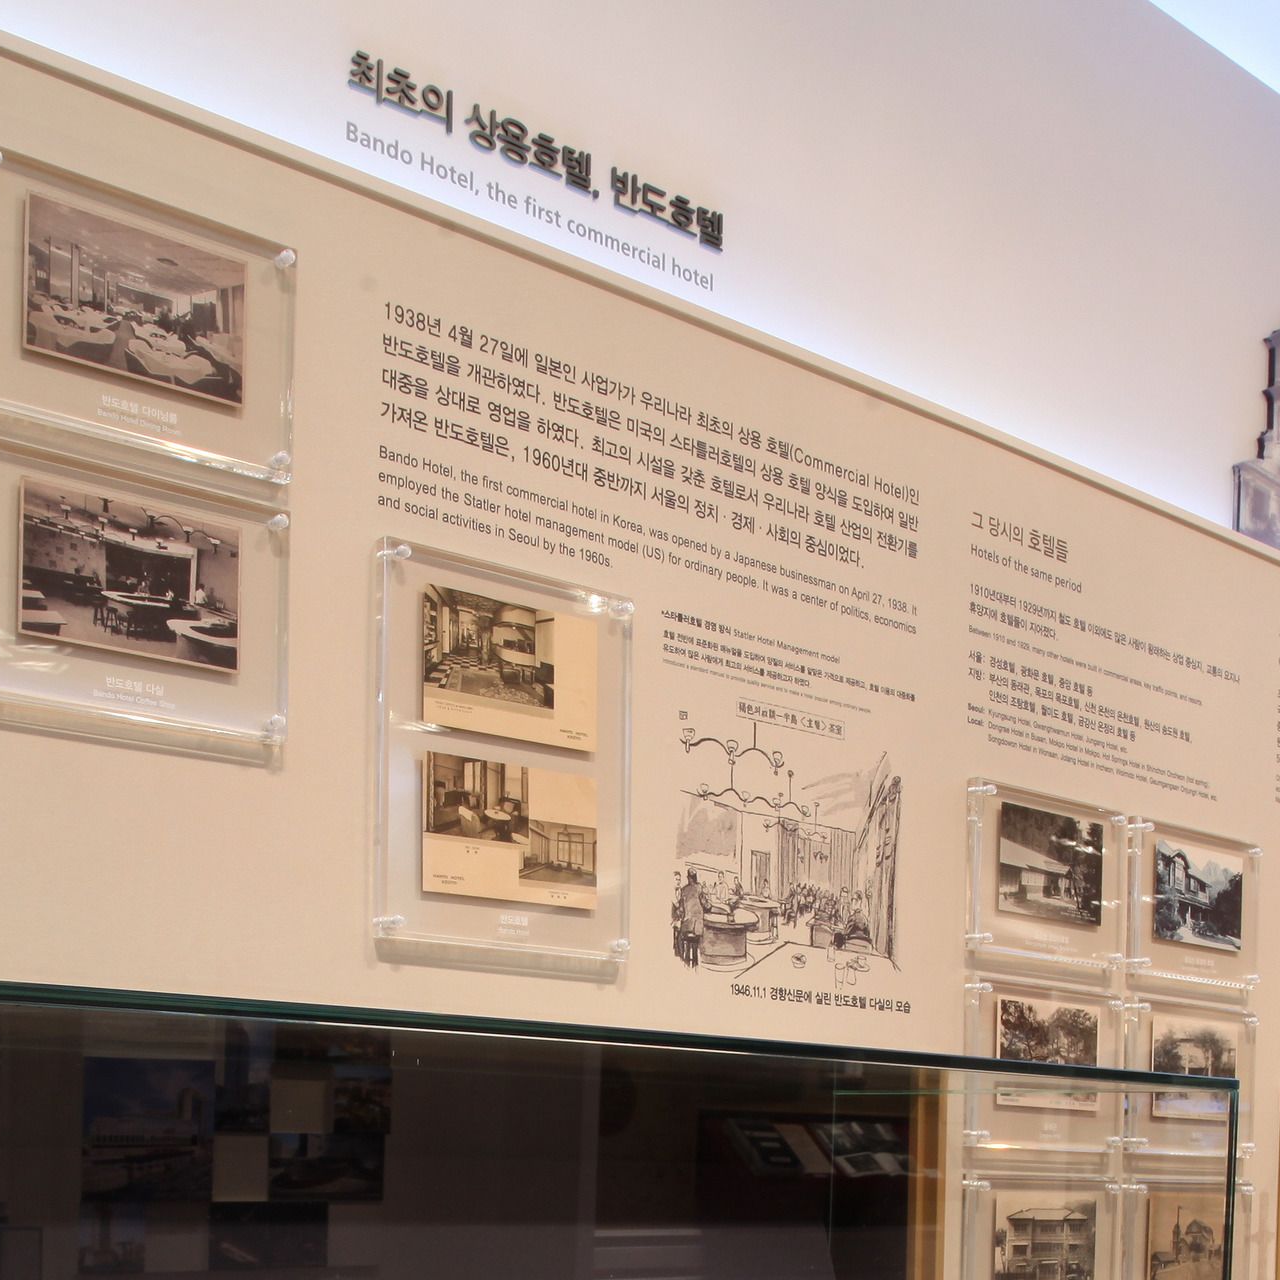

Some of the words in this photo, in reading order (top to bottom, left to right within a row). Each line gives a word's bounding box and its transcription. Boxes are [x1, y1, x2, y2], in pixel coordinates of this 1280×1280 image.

[346, 121, 412, 165] Bando
[421, 152, 479, 196] Hotel,
[486, 182, 518, 209] the
[524, 196, 561, 228] first
[567, 220, 665, 272] commercial
[672, 257, 713, 291] hotel
[347, 50, 453, 136] 최초의
[465, 103, 599, 202] 상용호텔,
[611, 166, 723, 254] 반도호텔
[381, 402, 428, 432] 가져온
[435, 417, 514, 459] 반도호텔은,
[524, 446, 588, 482] 1960년대
[593, 467, 646, 499] 중반까지
[651, 486, 689, 512] 서울의
[694, 499, 718, 521] 정치
[731, 512, 754, 533] 경제
[766, 523, 800, 548] 사회의
[805, 535, 864, 568] 중심이었다.
[382, 368, 429, 400] 대중을
[435, 385, 481, 415] 상대로
[488, 402, 531, 432] 영업을
[537, 418, 583, 449] 하였다.
[592, 436, 631, 465] 최고의
[637, 452, 676, 479] 시설을
[681, 466, 705, 489] 갖춘
[710, 476, 758, 506] 호텔로서
[763, 493, 809, 522] 우리나라
[813, 510, 835, 531] 호텔
[840, 519, 872, 543] 산업의
[877, 531, 918, 557] 전환기를
[383, 334, 461, 377] 반도호텔을
[467, 363, 545, 405] 개관하였다.
[554, 391, 621, 430] 반도호텔은
[627, 418, 665, 446] 미국의
[670, 433, 756, 477] 스타틀러호텔의
[760, 464, 784, 486] 상용
[788, 473, 810, 495] 호텔
[815, 482, 848, 505] 양식을
[852, 496, 894, 522] 도입하여
[898, 512, 918, 531] 일반
[385, 302, 440, 338] 1938년
[448, 325, 472, 349] 4월
[480, 335, 528, 367] 27일에
[535, 354, 575, 383] 일본인
[581, 371, 635, 405] 사업가가
[640, 391, 692, 425] 우리나라
[697, 411, 733, 439] 최초의
[738, 427, 762, 449] 상용
[766, 437, 869, 487] 호텔(Commercial
[874, 476, 919, 504] Hotel)인
[971, 512, 983, 529] 그
[989, 517, 1023, 546] 당시의
[1028, 529, 1068, 563] 호텔들
[971, 544, 999, 563] Hotels
[1002, 556, 1011, 568] of
[1014, 560, 1028, 574] the
[1031, 568, 1052, 583] same
[1055, 577, 1081, 593] period
[815, 992, 831, 1005] 실린
[834, 994, 866, 1009] 반도호텔
[869, 998, 893, 1012] 다실의
[895, 1001, 911, 1014] 모습
